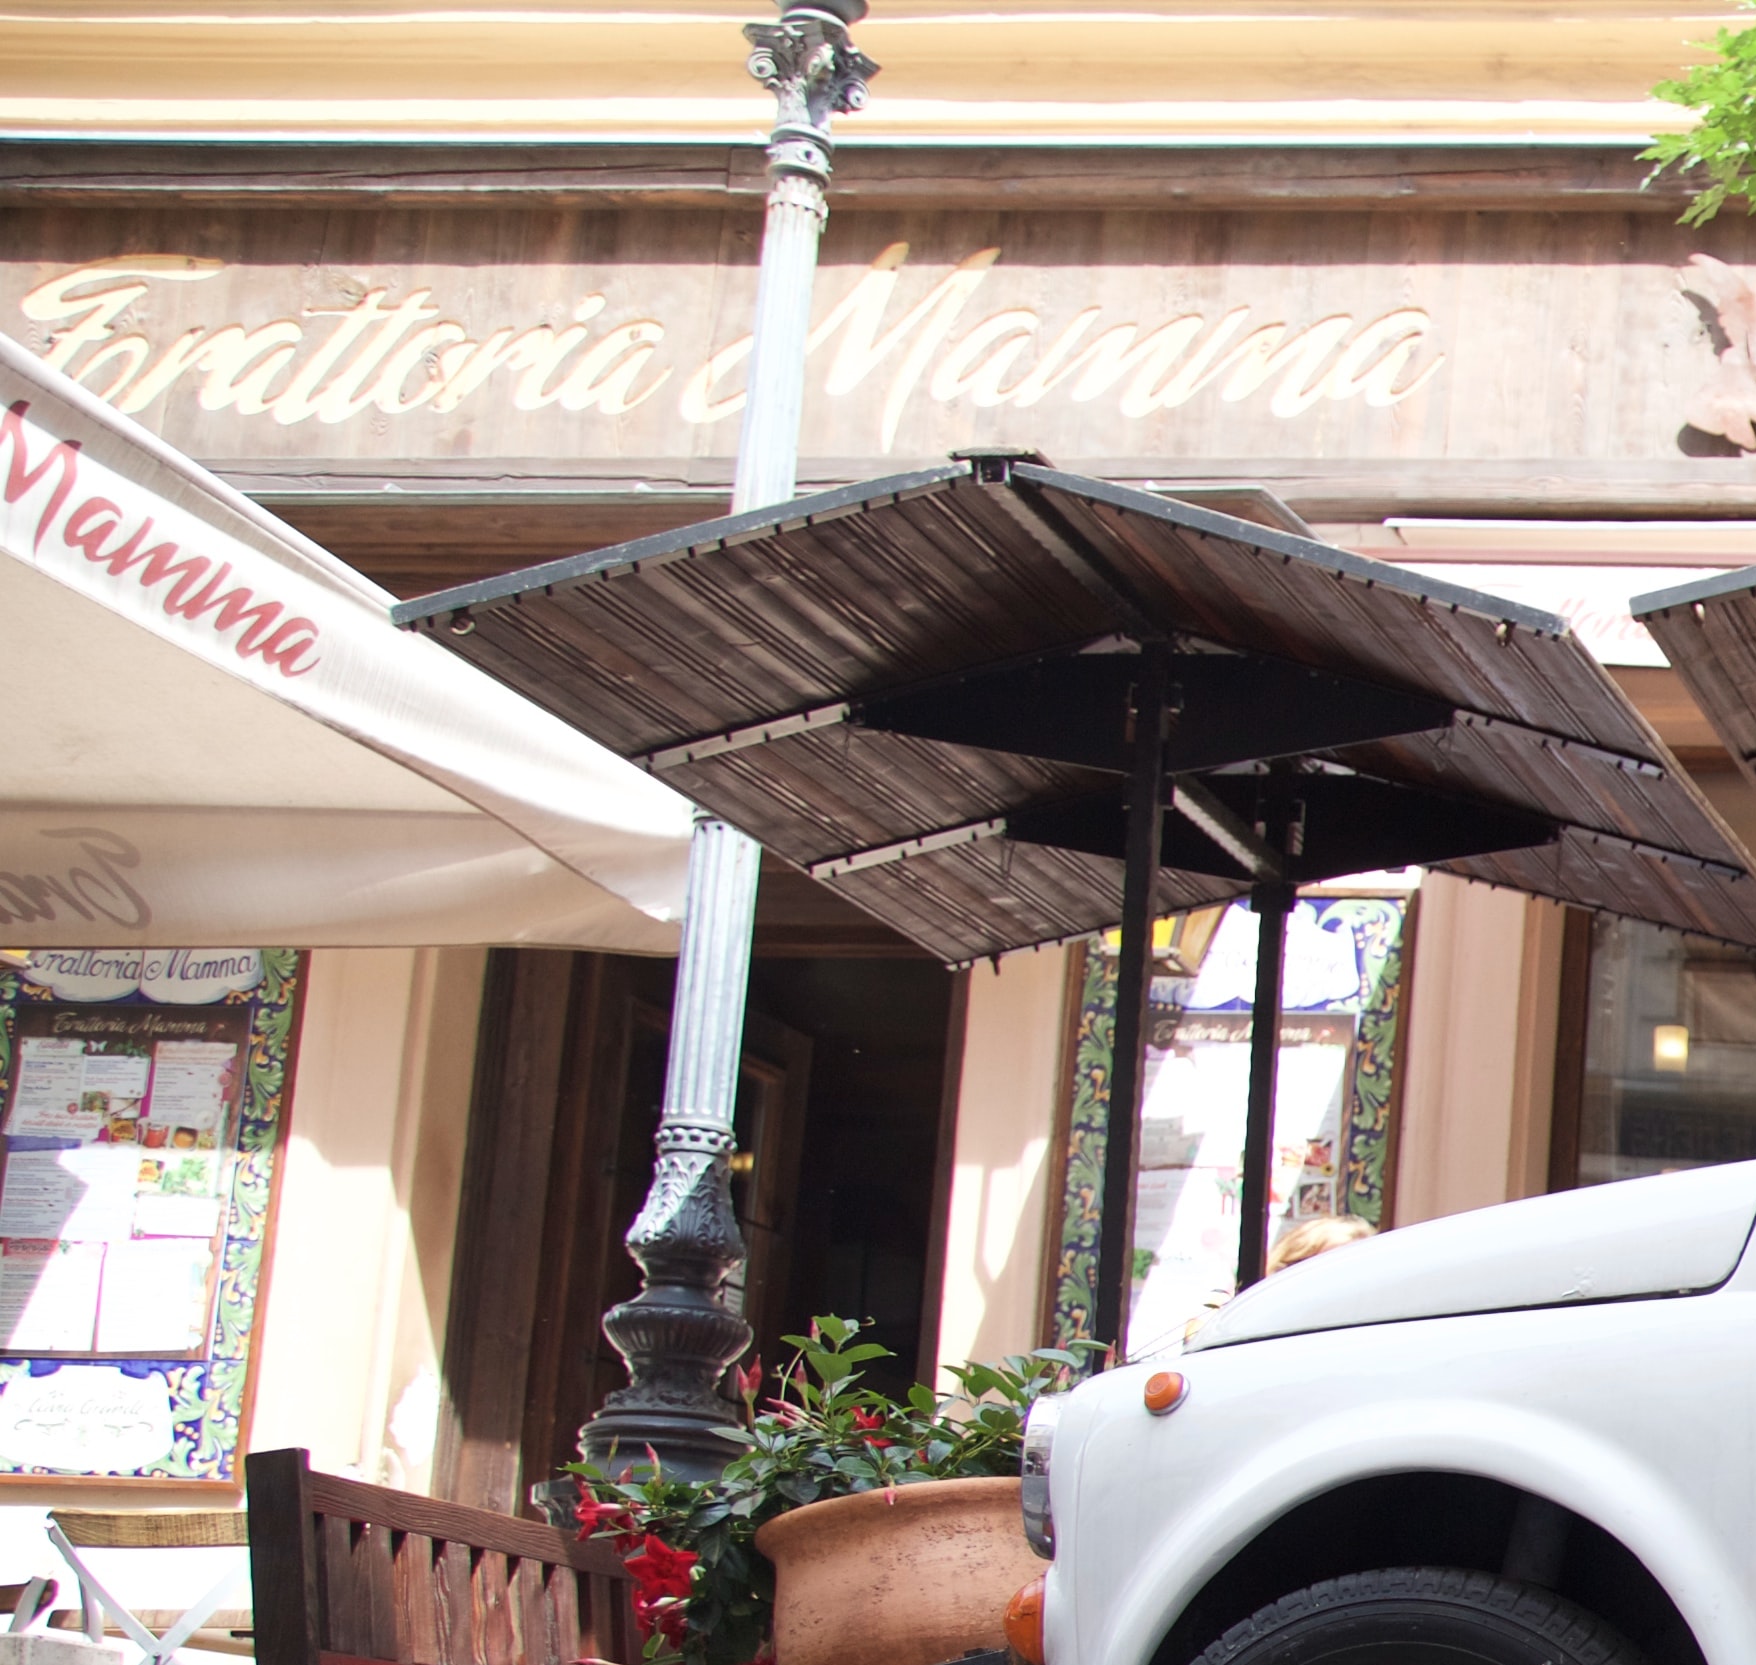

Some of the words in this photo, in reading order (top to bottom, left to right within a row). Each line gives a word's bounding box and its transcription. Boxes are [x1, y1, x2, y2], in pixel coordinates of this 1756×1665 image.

[680, 241, 1446, 455] Mamma
[0, 399, 321, 679] Mamma
[143, 950, 257, 982] Mamma
[53, 1012, 128, 1035] Trattoria
[128, 1012, 208, 1037] Mamma
[1153, 1019, 1229, 1042] Trattoria
